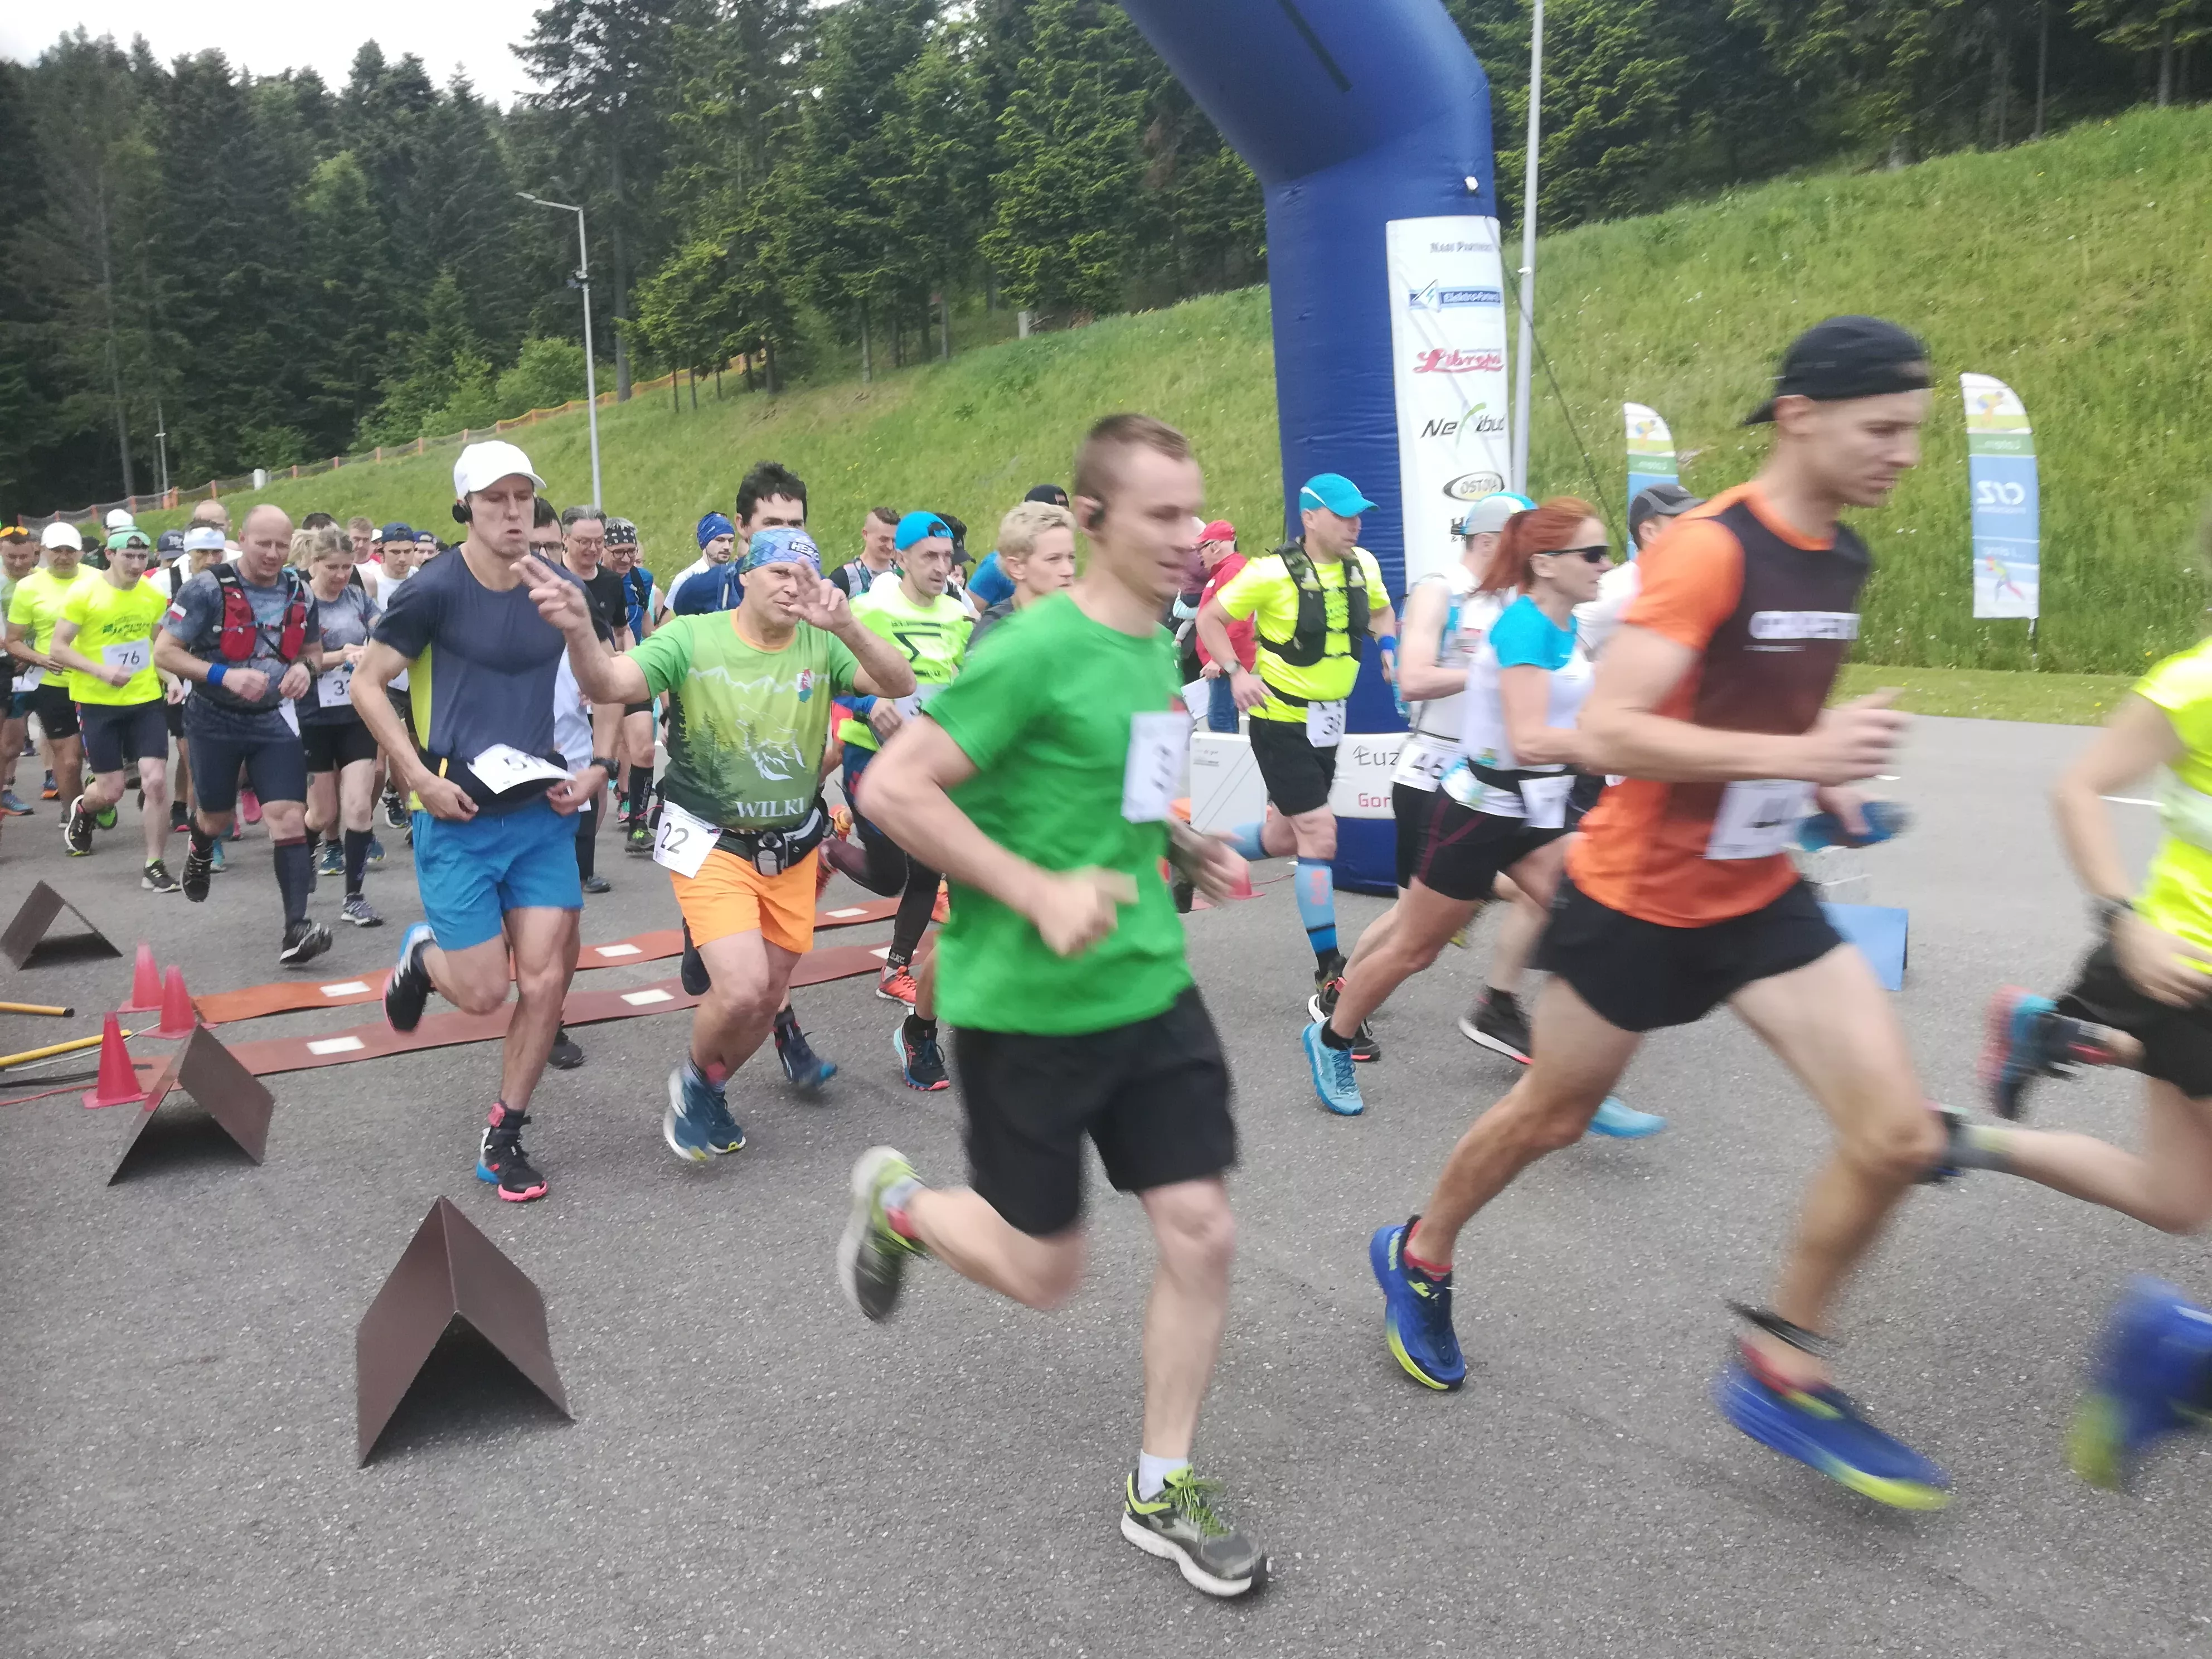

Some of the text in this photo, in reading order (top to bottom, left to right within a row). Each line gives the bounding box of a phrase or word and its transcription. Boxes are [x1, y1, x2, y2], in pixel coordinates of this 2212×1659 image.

[118, 650, 140, 666] 76
[735, 797, 804, 817] WILKI
[660, 822, 689, 855] 22
